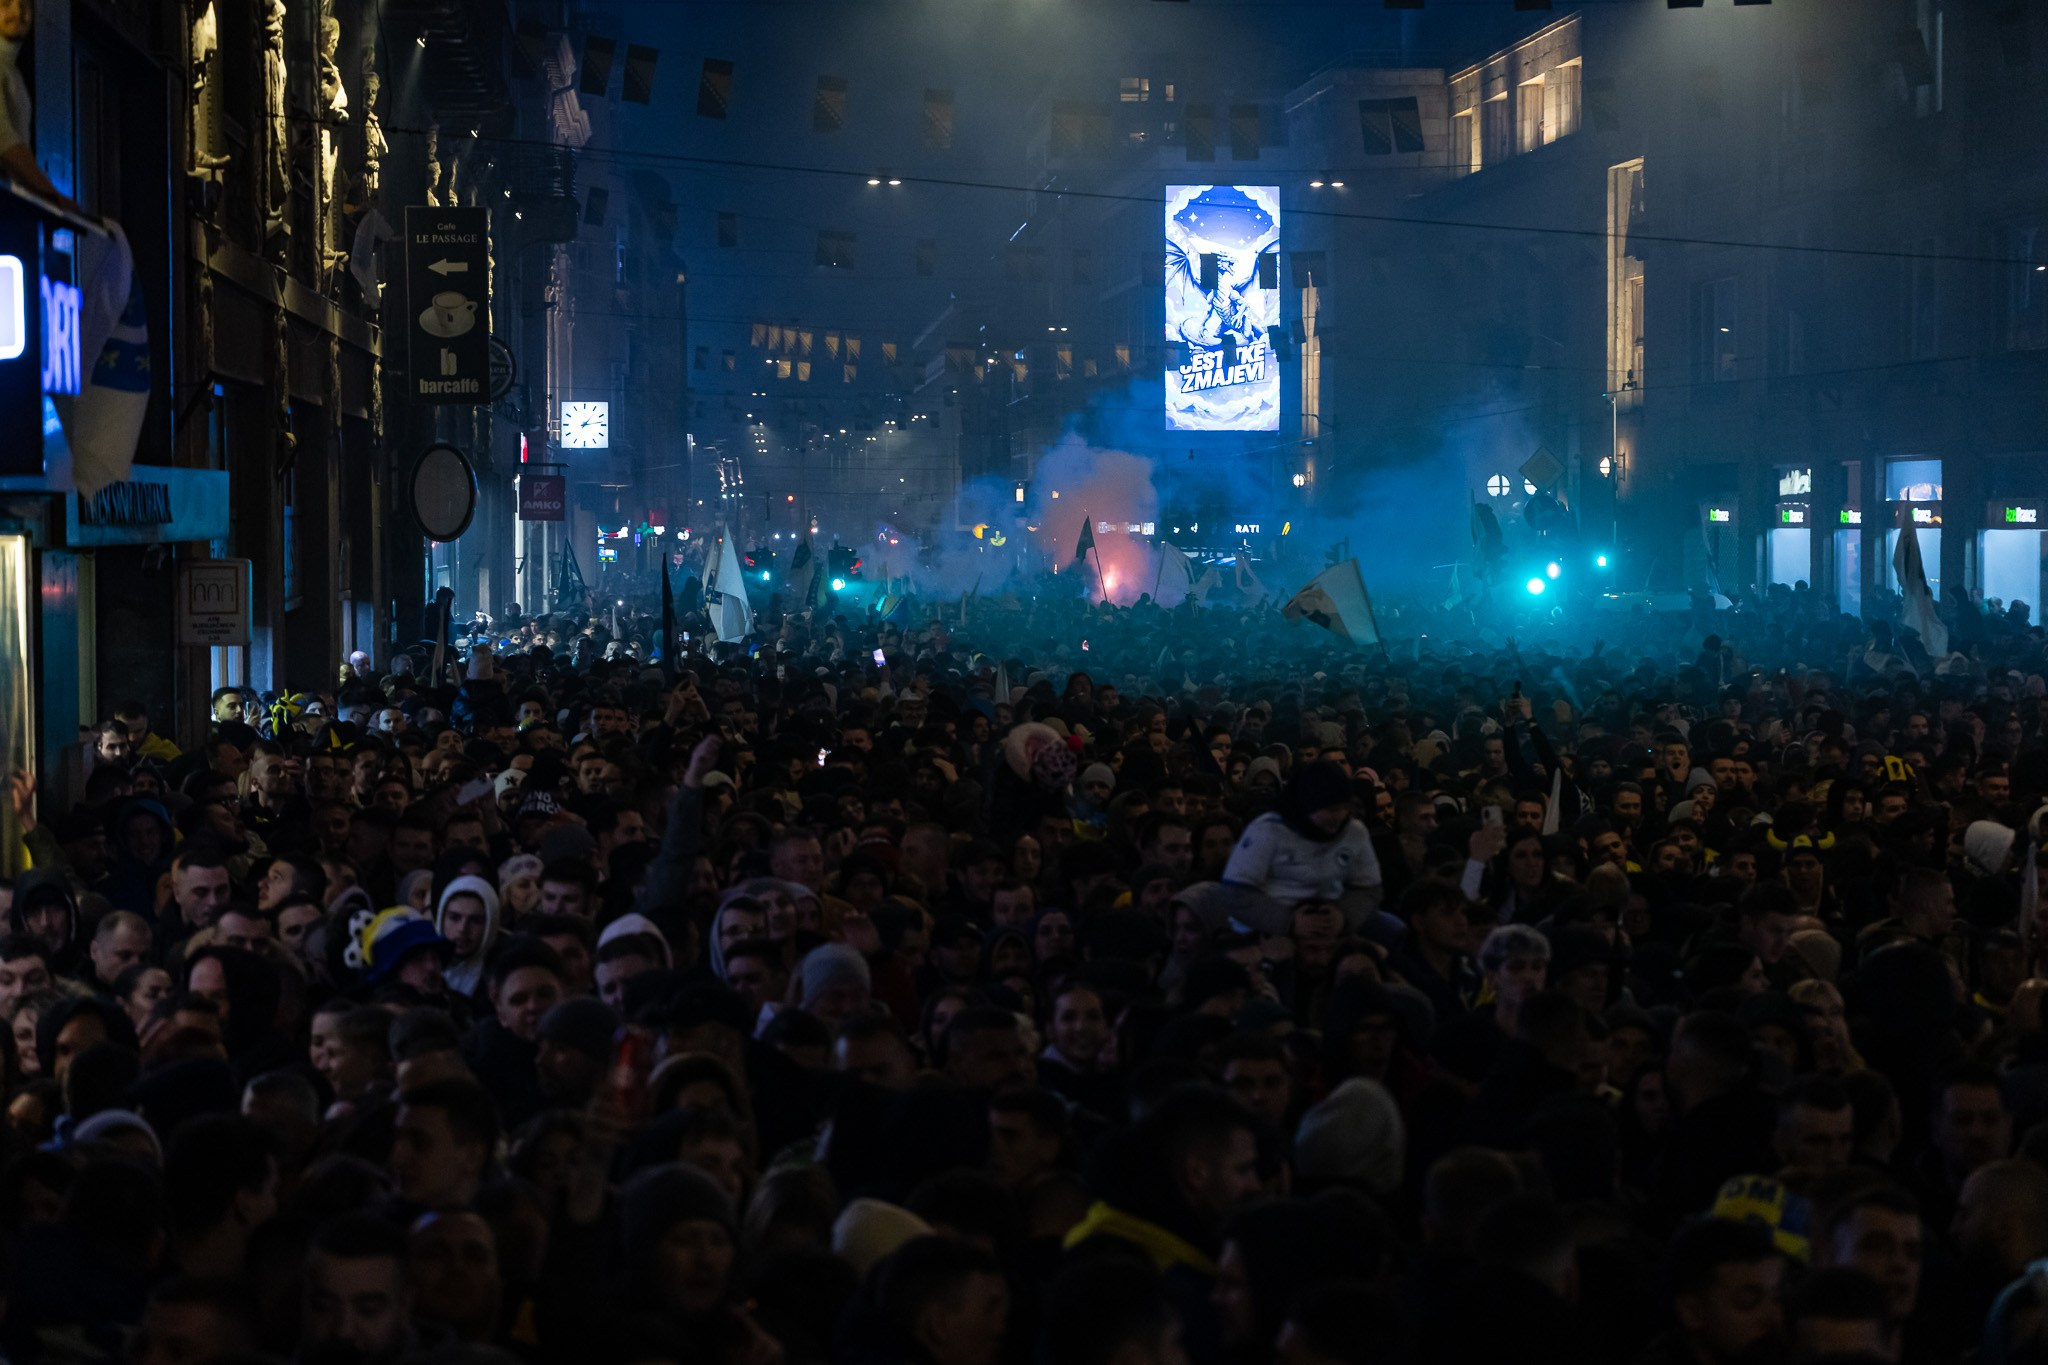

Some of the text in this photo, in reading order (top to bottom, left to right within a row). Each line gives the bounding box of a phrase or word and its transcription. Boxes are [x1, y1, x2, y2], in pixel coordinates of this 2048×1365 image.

[416, 234, 478, 243] LE PASSAGE
[1181, 360, 1265, 393] ZMAJEVI
[523, 500, 561, 510] AMKO
